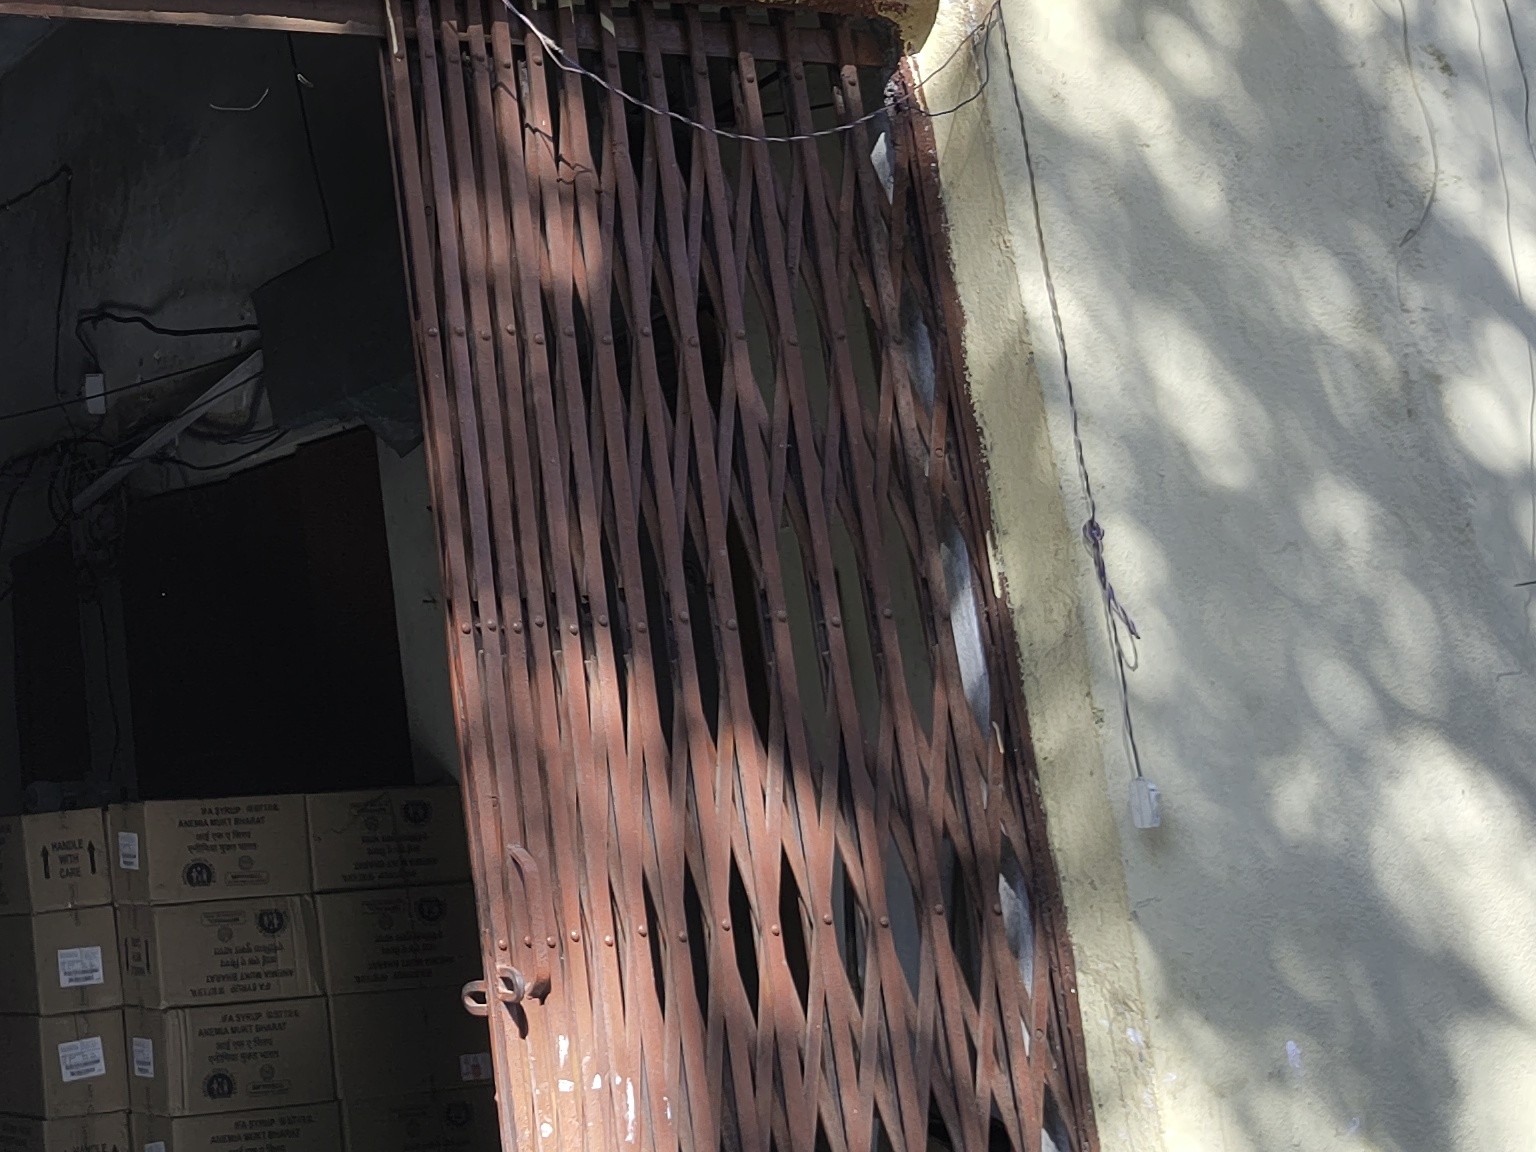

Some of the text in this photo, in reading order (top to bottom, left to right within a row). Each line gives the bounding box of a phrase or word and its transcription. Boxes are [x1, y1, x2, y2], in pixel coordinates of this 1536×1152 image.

[51, 838, 84, 851] HANDLE
[58, 853, 80, 865] WITH
[59, 866, 81, 879] CARE
